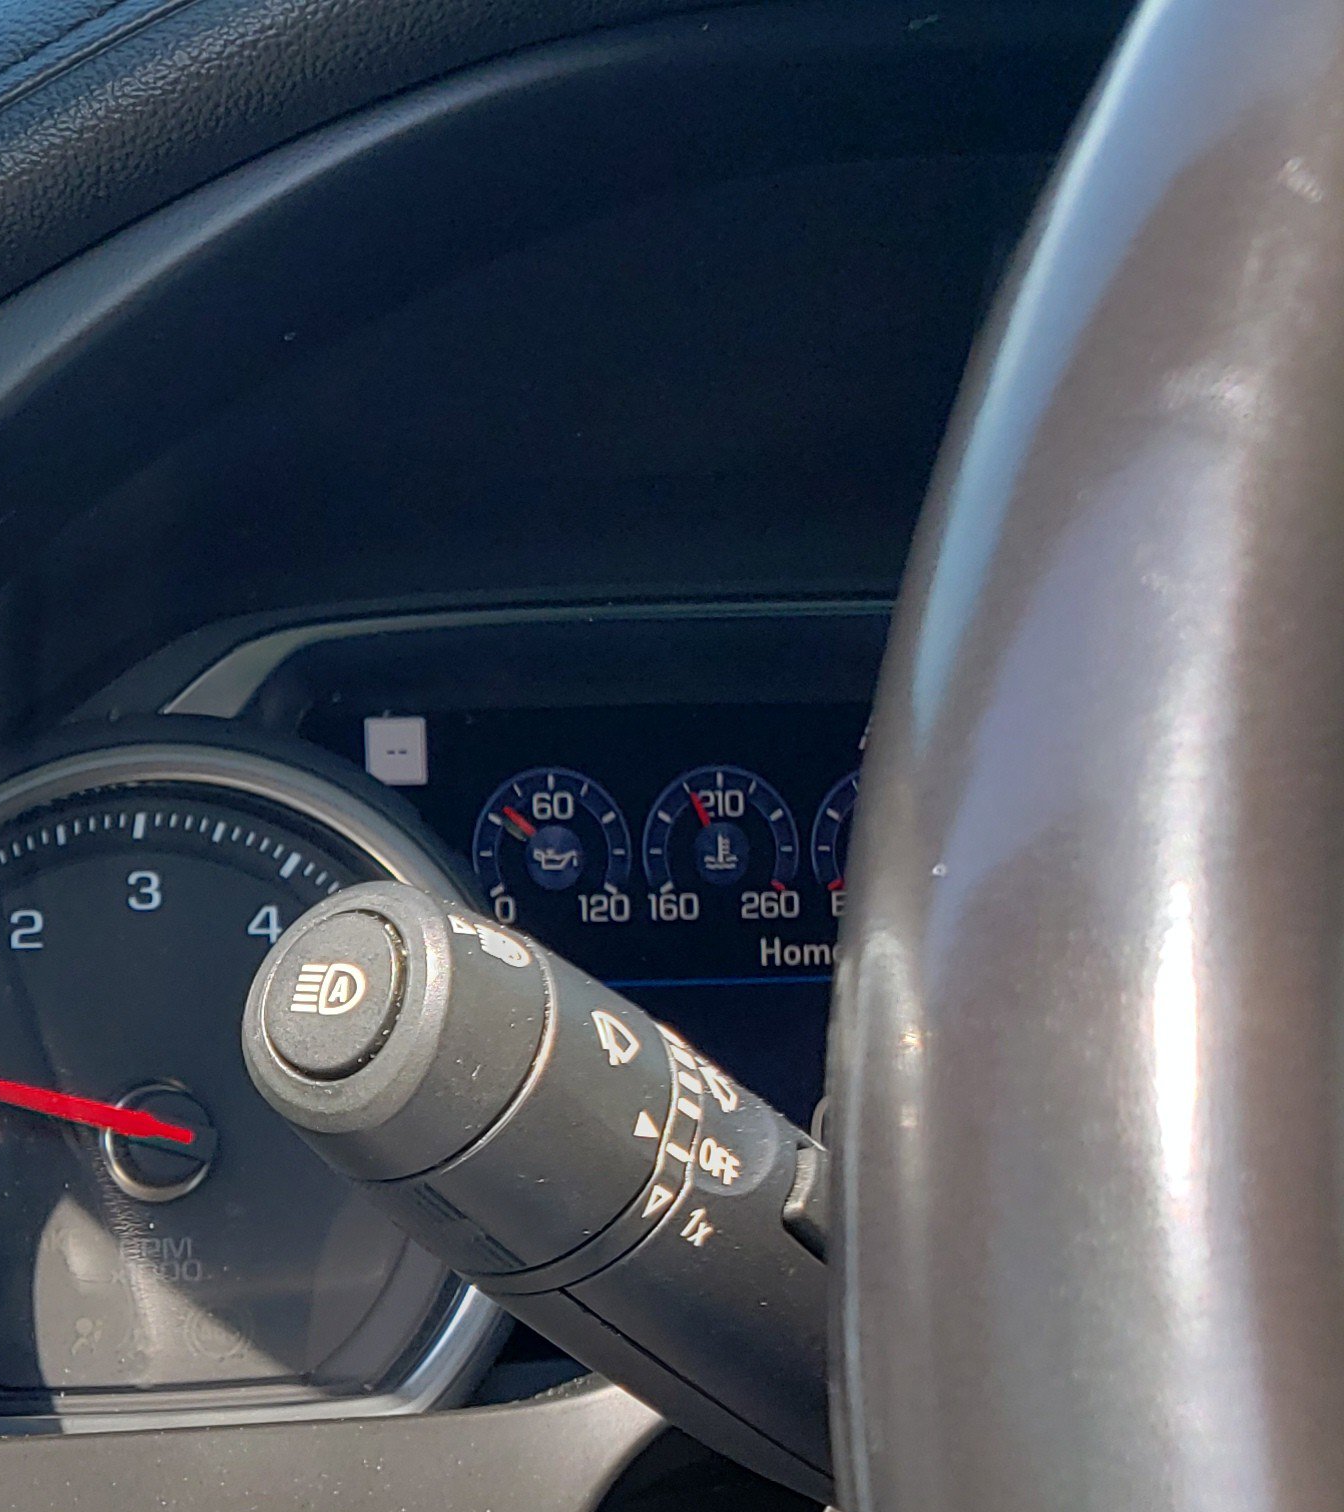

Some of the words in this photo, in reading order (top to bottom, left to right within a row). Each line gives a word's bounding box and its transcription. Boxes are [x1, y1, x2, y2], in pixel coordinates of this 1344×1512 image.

[532, 791, 574, 820] 60
[697, 789, 744, 818] 210
[127, 870, 162, 911] 3
[740, 890, 800, 919] 260
[495, 895, 516, 924] 0
[577, 893, 630, 922] 120
[647, 892, 700, 921] 160
[10, 909, 43, 949] 2
[247, 904, 283, 943] 4
[699, 1138, 740, 1185] OFF
